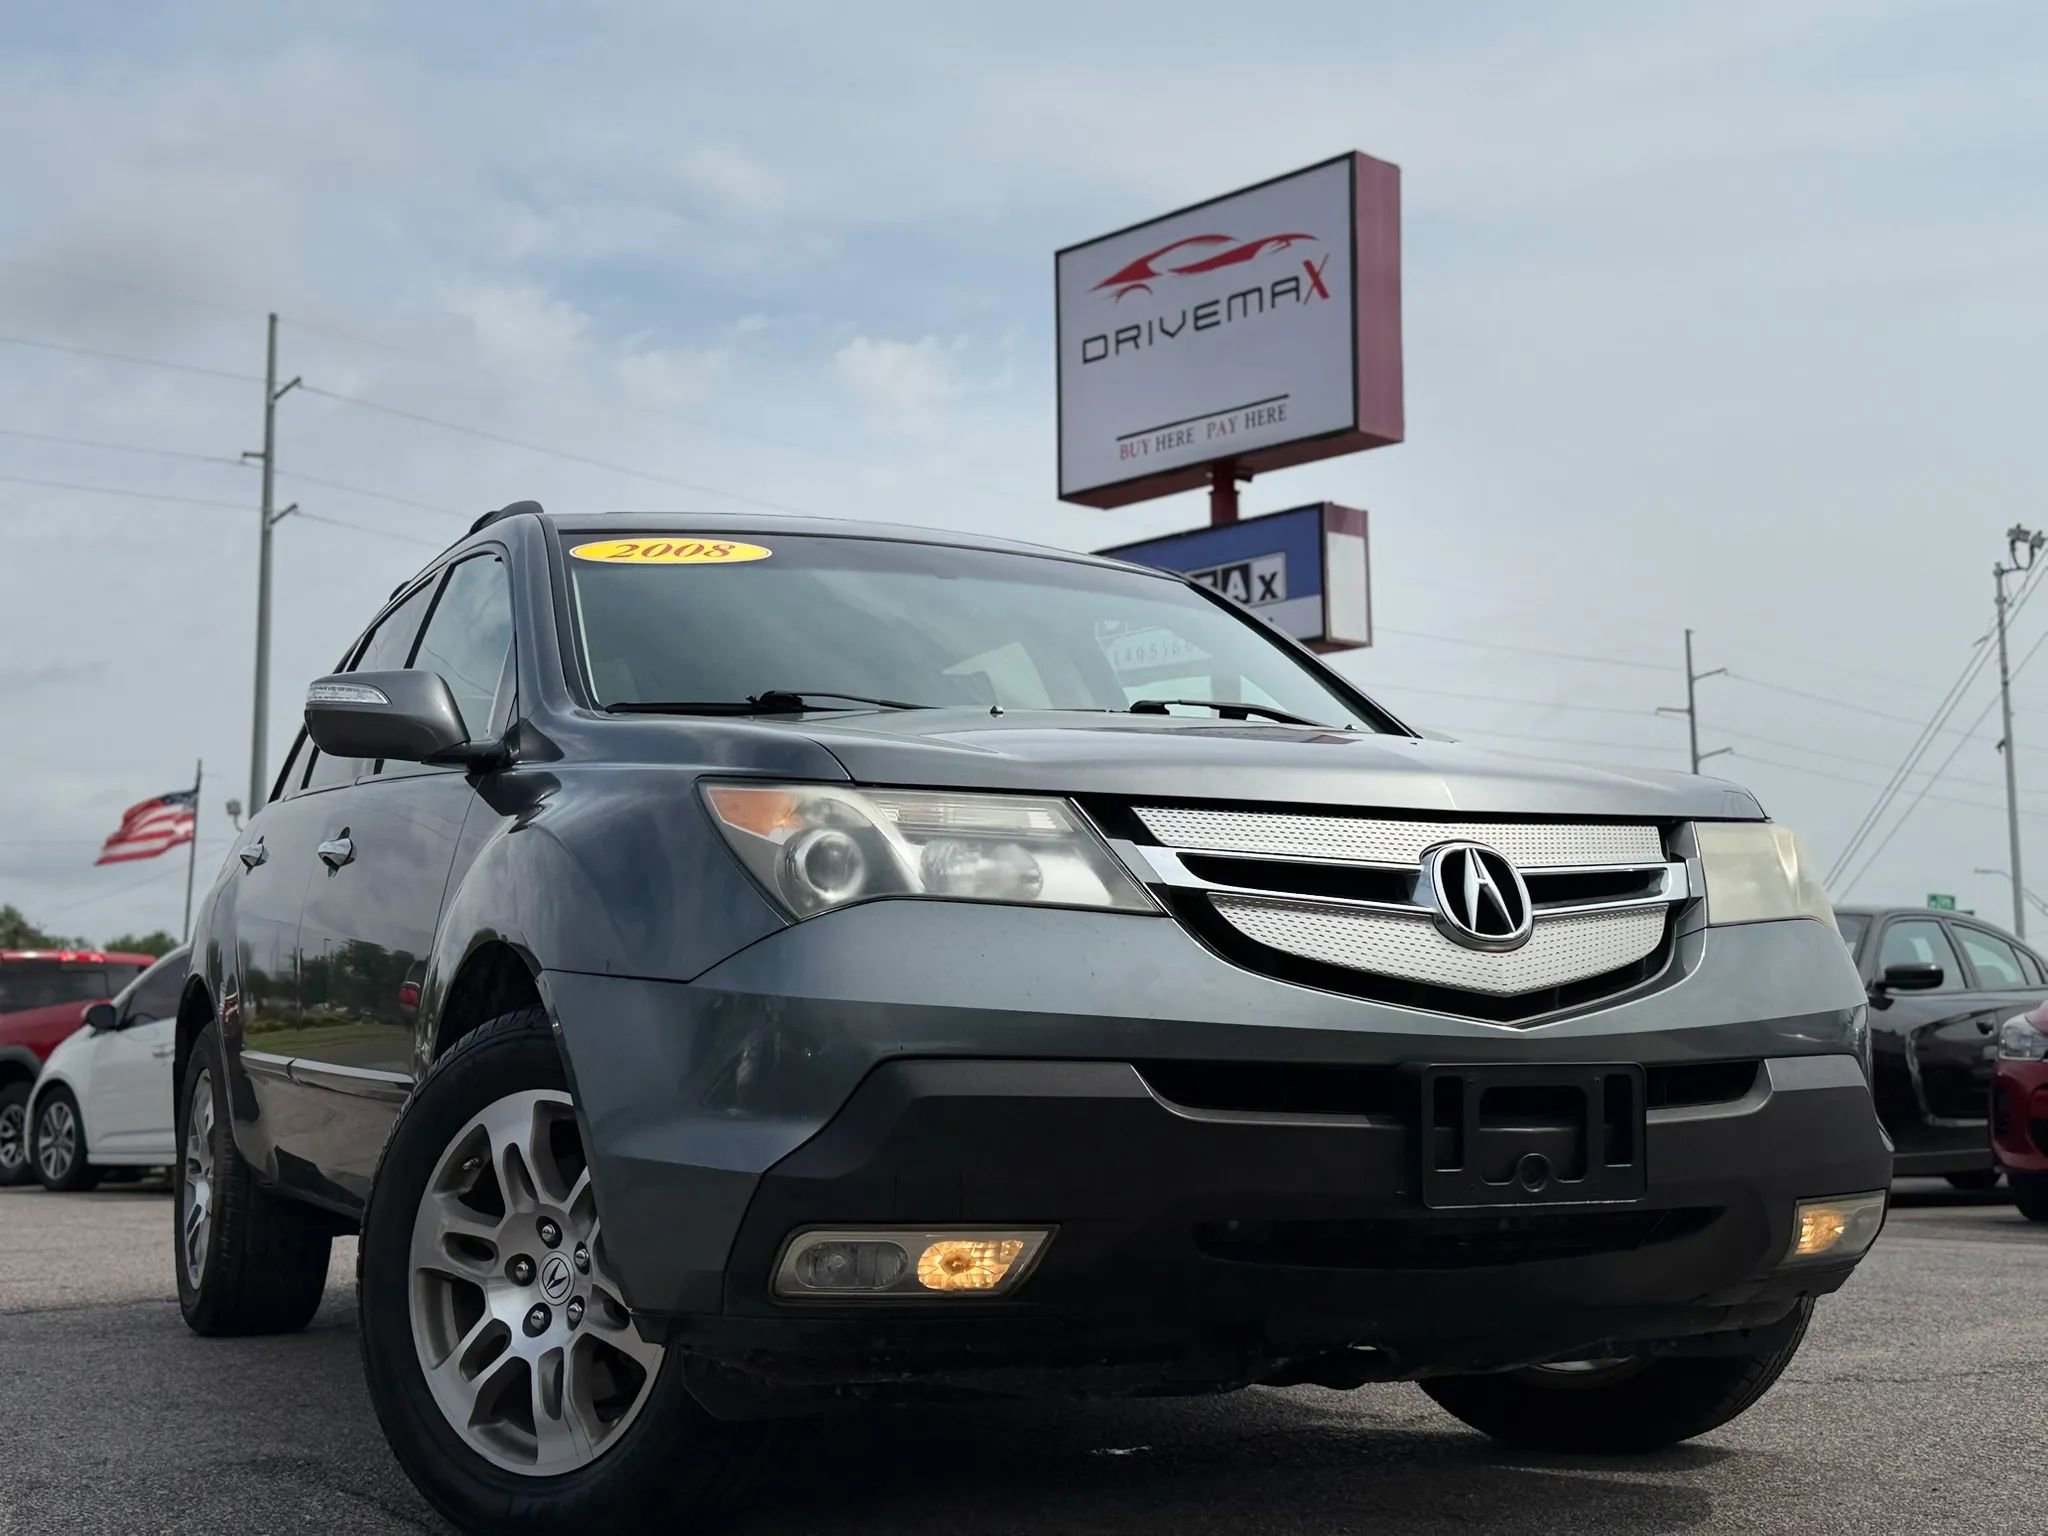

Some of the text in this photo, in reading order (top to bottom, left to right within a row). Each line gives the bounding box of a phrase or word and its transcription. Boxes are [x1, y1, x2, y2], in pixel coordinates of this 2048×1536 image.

[1082, 253, 1329, 364] DRIVEMAX
[1119, 403, 1287, 461] BUY HERE PAY HERE
[606, 543, 736, 559] 2008
